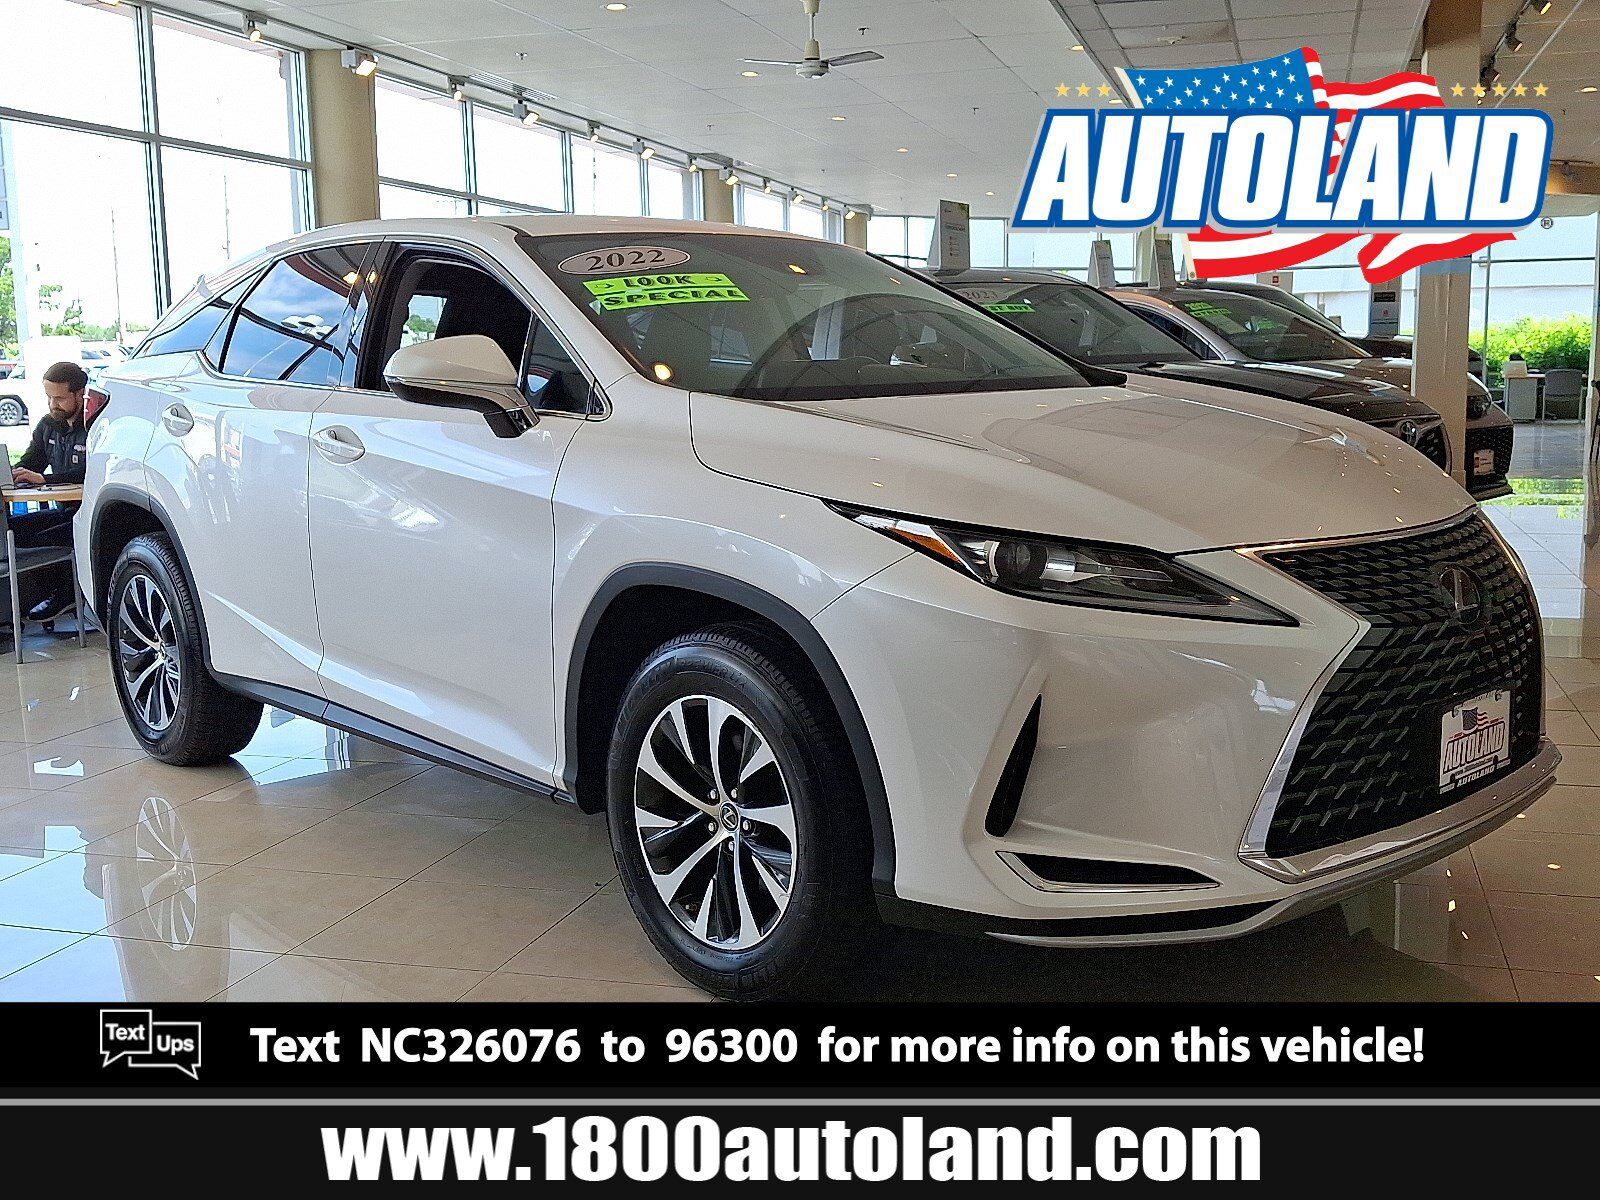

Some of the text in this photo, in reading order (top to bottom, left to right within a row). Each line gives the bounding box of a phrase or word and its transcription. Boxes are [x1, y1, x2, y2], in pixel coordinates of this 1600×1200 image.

[585, 250, 666, 272] 2022
[622, 275, 695, 289] LOOK
[603, 288, 745, 306] SPECIAL
[1443, 721, 1505, 774] AUTOLAND
